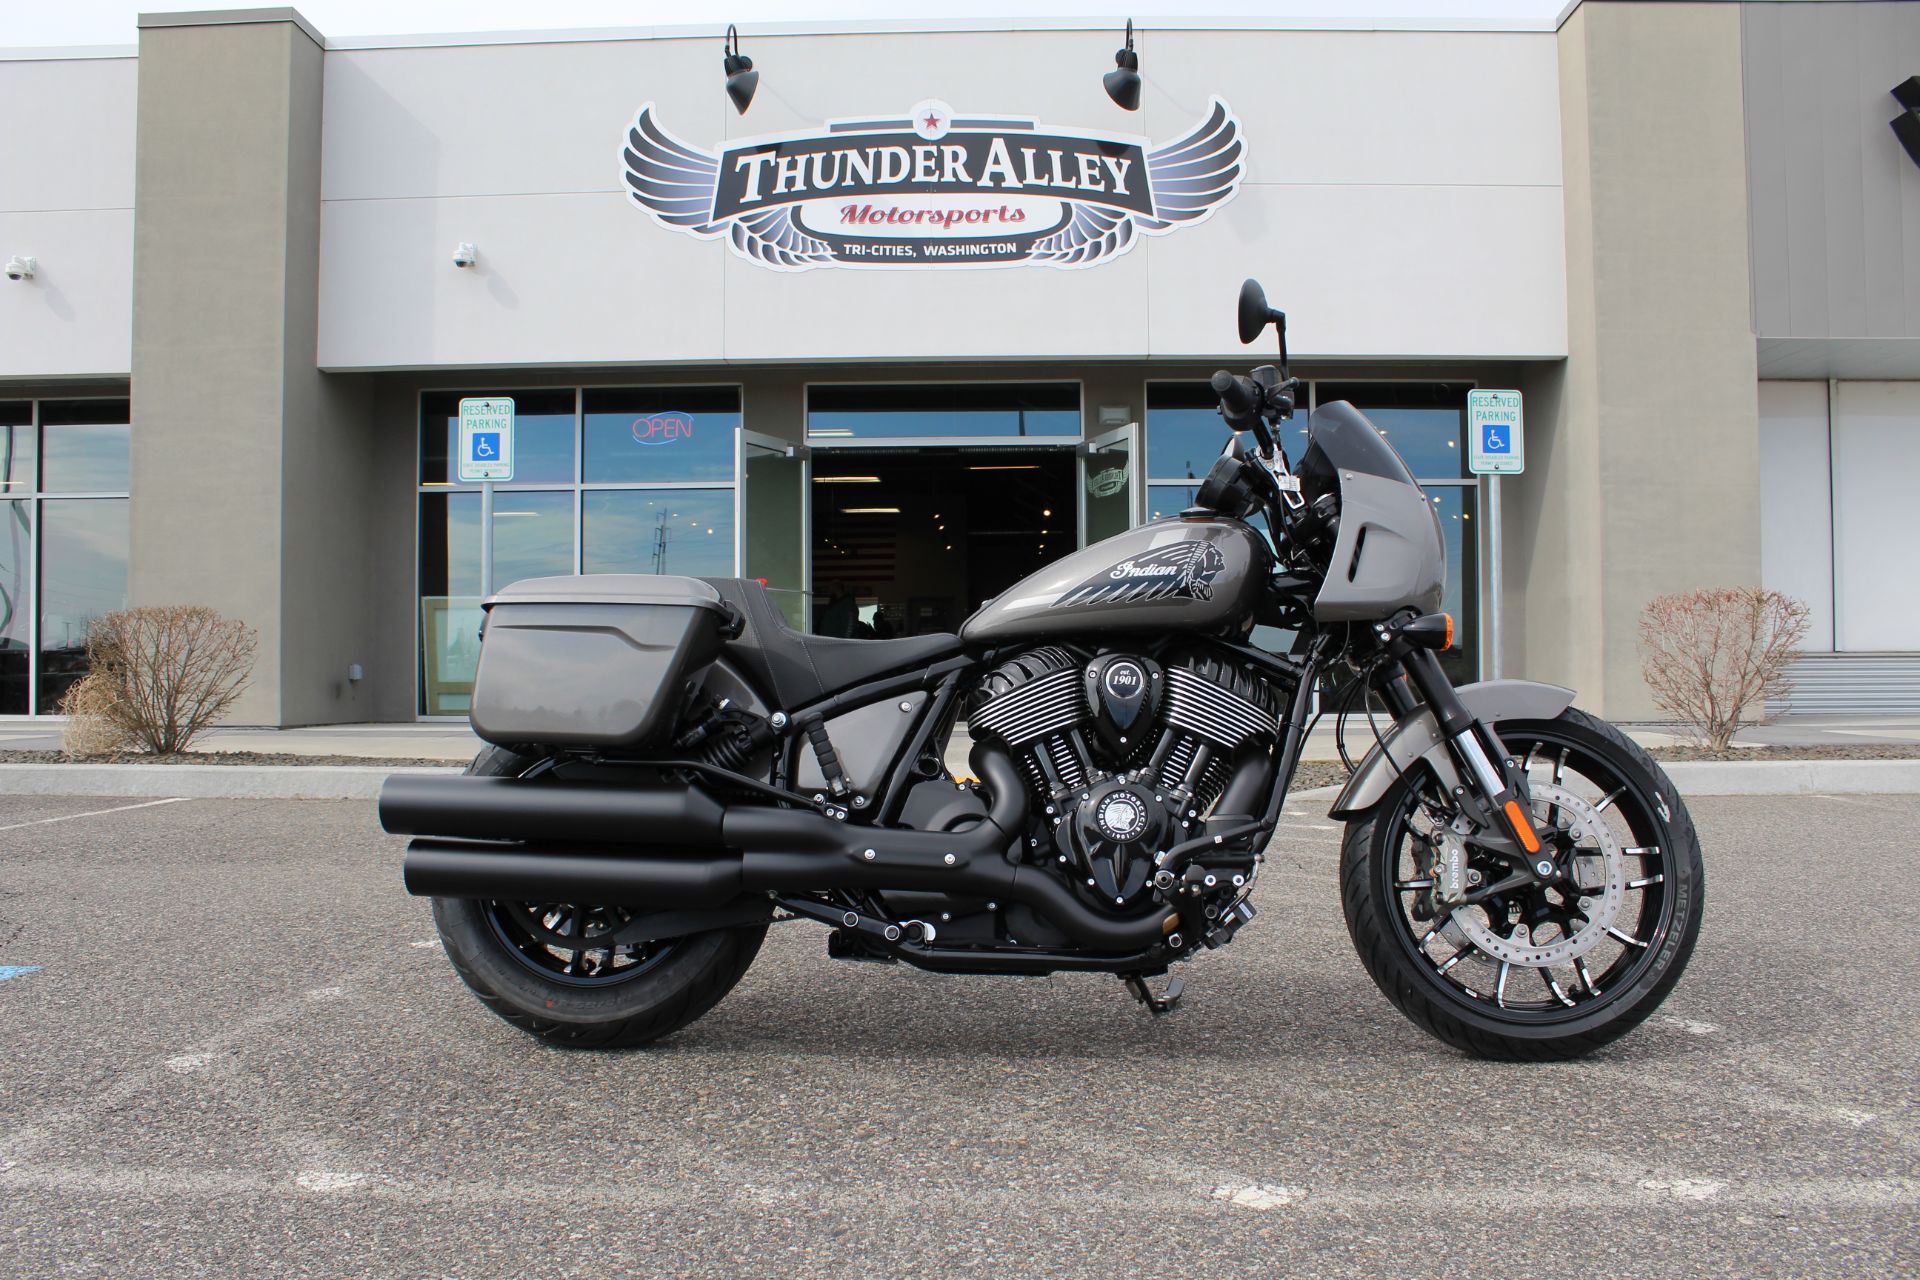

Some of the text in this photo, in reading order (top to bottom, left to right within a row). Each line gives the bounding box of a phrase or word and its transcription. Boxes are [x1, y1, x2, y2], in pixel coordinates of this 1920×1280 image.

[735, 137, 1132, 203] THUNDER ALLEY
[840, 204, 1026, 229] Motorsports
[843, 242, 1017, 258] TRI-CITIES, WASHINGTON
[463, 404, 511, 416] RESERVED
[1472, 396, 1519, 408] RESERVED
[466, 418, 507, 430] PARKING
[1476, 410, 1516, 422] PARKING
[632, 417, 692, 438] OPEN
[1109, 560, 1178, 579] Indian
[1112, 675, 1137, 686] 1901
[1098, 792, 1146, 832] INDIAN MOTORCYCLE
[1449, 849, 1459, 889] brembo
[1654, 884, 1688, 970] METZELER
